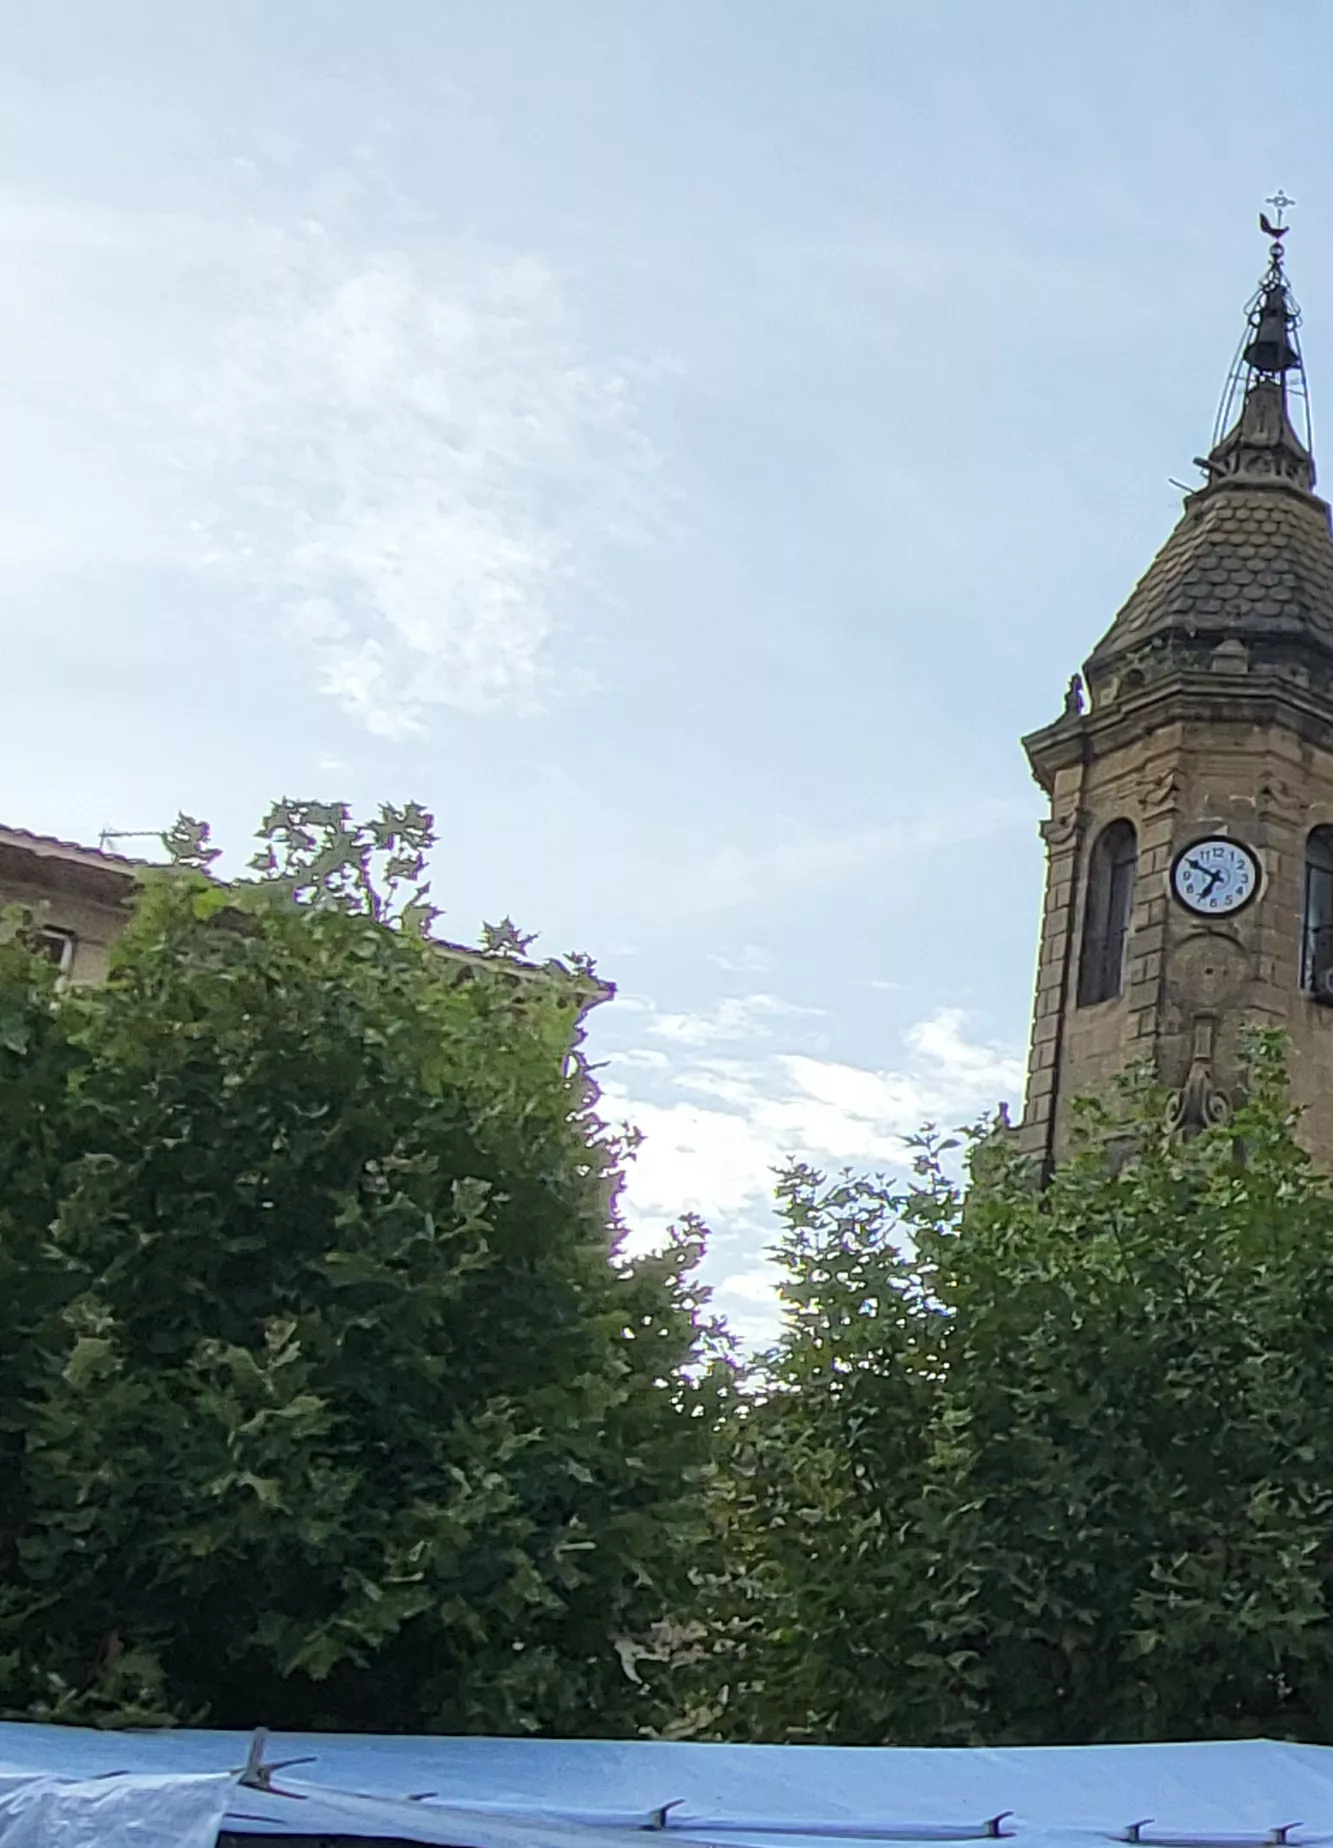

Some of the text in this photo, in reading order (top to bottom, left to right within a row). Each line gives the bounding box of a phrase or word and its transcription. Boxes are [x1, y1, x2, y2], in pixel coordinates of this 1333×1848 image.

[1200, 850, 1210, 862] 11
[1212, 847, 1225, 858] 12
[1236, 860, 1245, 870] 2
[1183, 871, 1191, 881] 9
[1241, 873, 1249, 884] 3
[1236, 885, 1244, 896] 4
[1209, 897, 1218, 908] 6
[1224, 895, 1233, 906] 5
